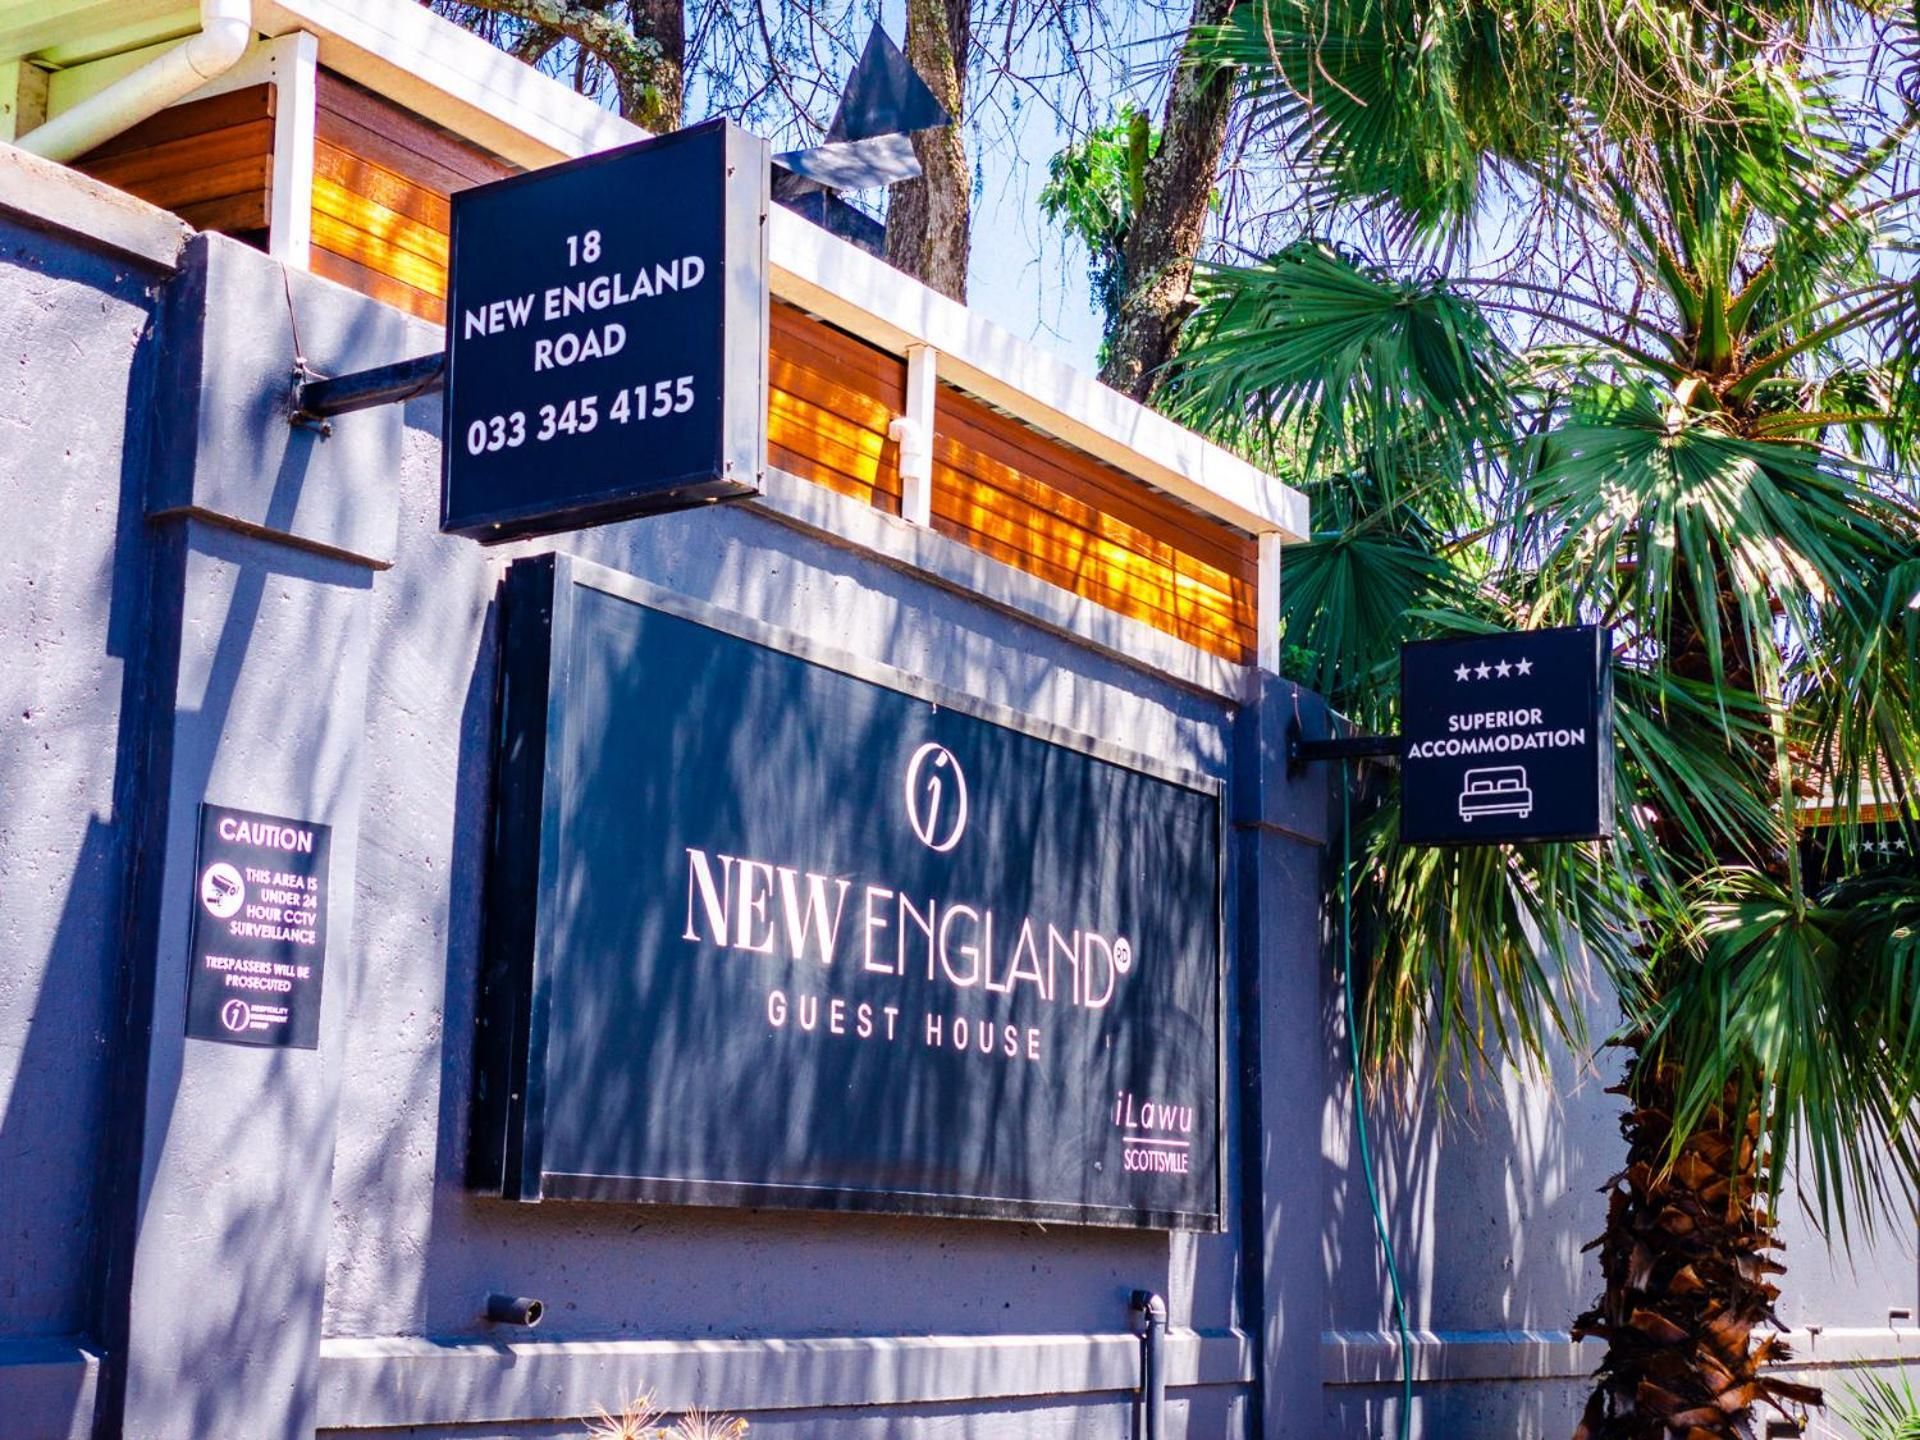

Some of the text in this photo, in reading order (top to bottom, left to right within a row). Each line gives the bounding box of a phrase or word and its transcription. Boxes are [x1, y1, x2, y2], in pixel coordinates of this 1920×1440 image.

[565, 229, 601, 267] 18
[464, 255, 706, 340] NEW ENGLAND
[533, 323, 627, 372] ROAD
[467, 375, 695, 456] 033 345 4155
[1448, 708, 1544, 732] SUPERIOR
[1407, 728, 1586, 759] ACCOMMODATION
[219, 818, 313, 853] CAUTION
[245, 867, 318, 891] THIS AREA IS
[261, 888, 317, 909] UNDER 24
[246, 904, 317, 926] HOUR CCTV
[682, 847, 851, 965] NEW
[863, 886, 1116, 1009] ENGLAND
[230, 920, 316, 945] SURVEILLANCE
[205, 955, 310, 979] TRESPASSERS WILL BE
[225, 973, 292, 993] PROSECUTED
[767, 990, 1041, 1060] GUEST HOUSE
[1115, 1090, 1192, 1133] iLawu
[1123, 1149, 1188, 1174] SCOTTSVILLE
